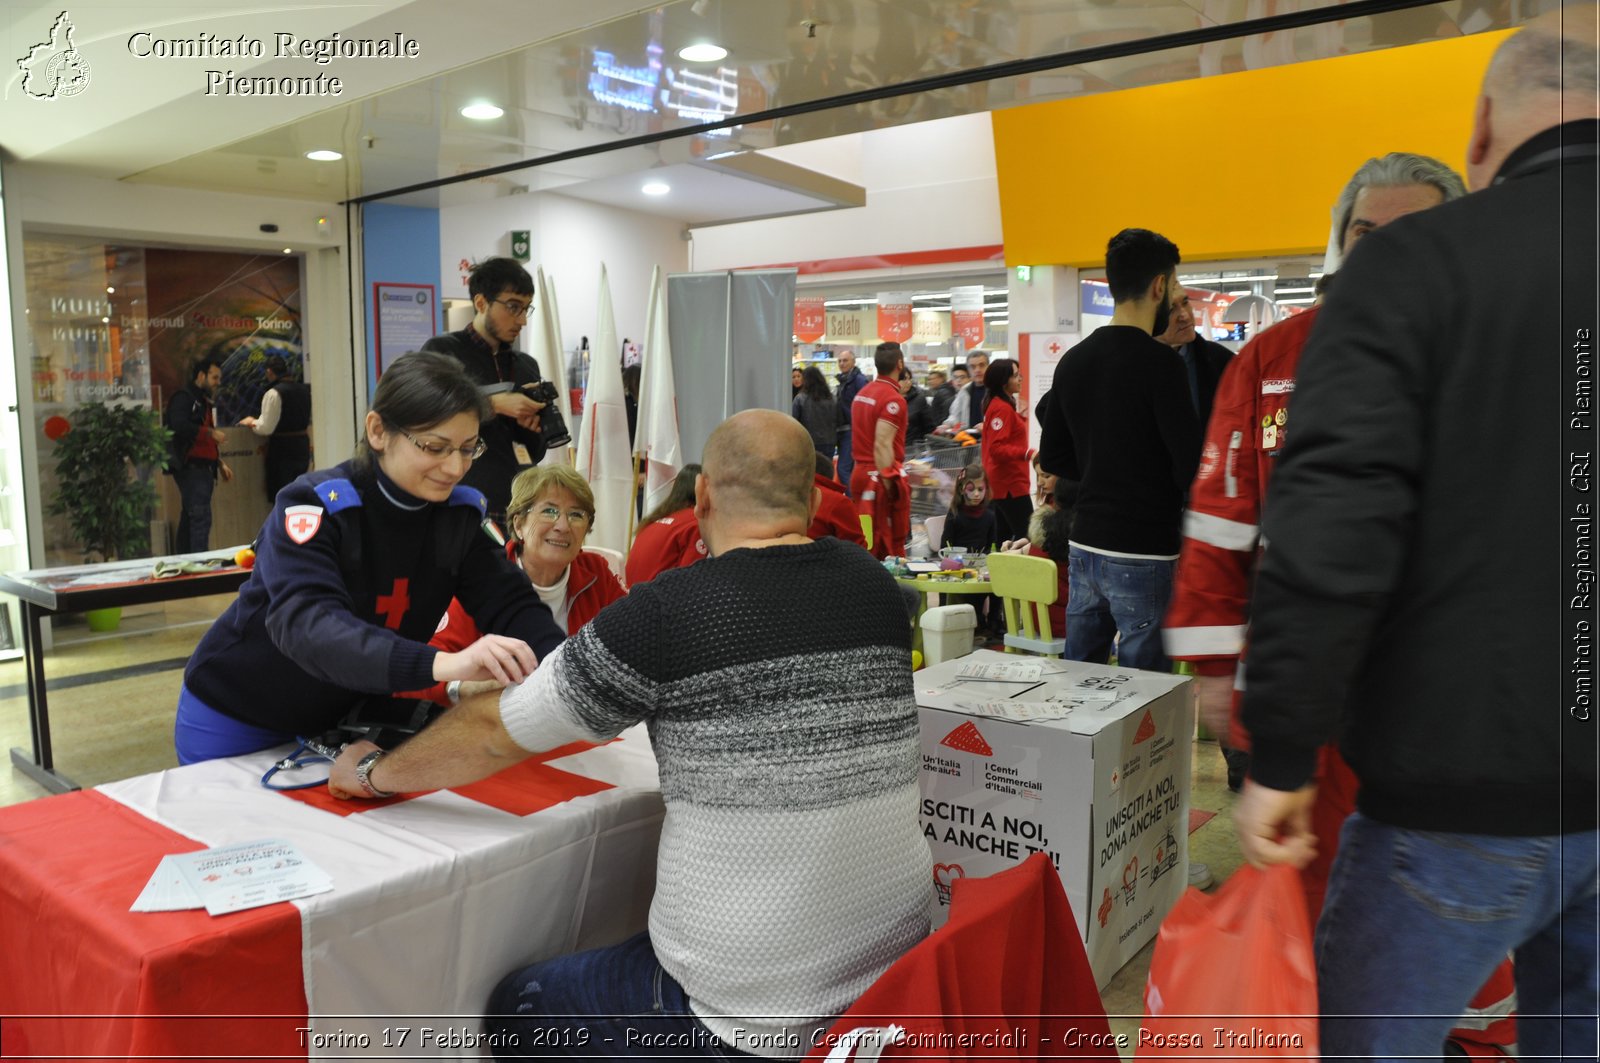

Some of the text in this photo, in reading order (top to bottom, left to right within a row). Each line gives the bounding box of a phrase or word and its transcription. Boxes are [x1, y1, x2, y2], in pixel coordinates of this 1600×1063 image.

[121, 314, 185, 328] benvenuti
[256, 316, 293, 330] Torino
[831, 314, 860, 336] Salato
[923, 754, 961, 769] Un'Italia
[923, 763, 961, 777] che aiuta
[985, 762, 1018, 776] I Centri
[985, 772, 1042, 791] Commerciali
[985, 782, 1017, 795] d'Italia
[1106, 775, 1175, 839] UNISCITI A NOI,
[981, 811, 996, 832] A
[1004, 816, 1049, 847] NOI,
[1101, 791, 1180, 869] DONA ANCHE TU!
[944, 827, 1020, 860] ANCHE
